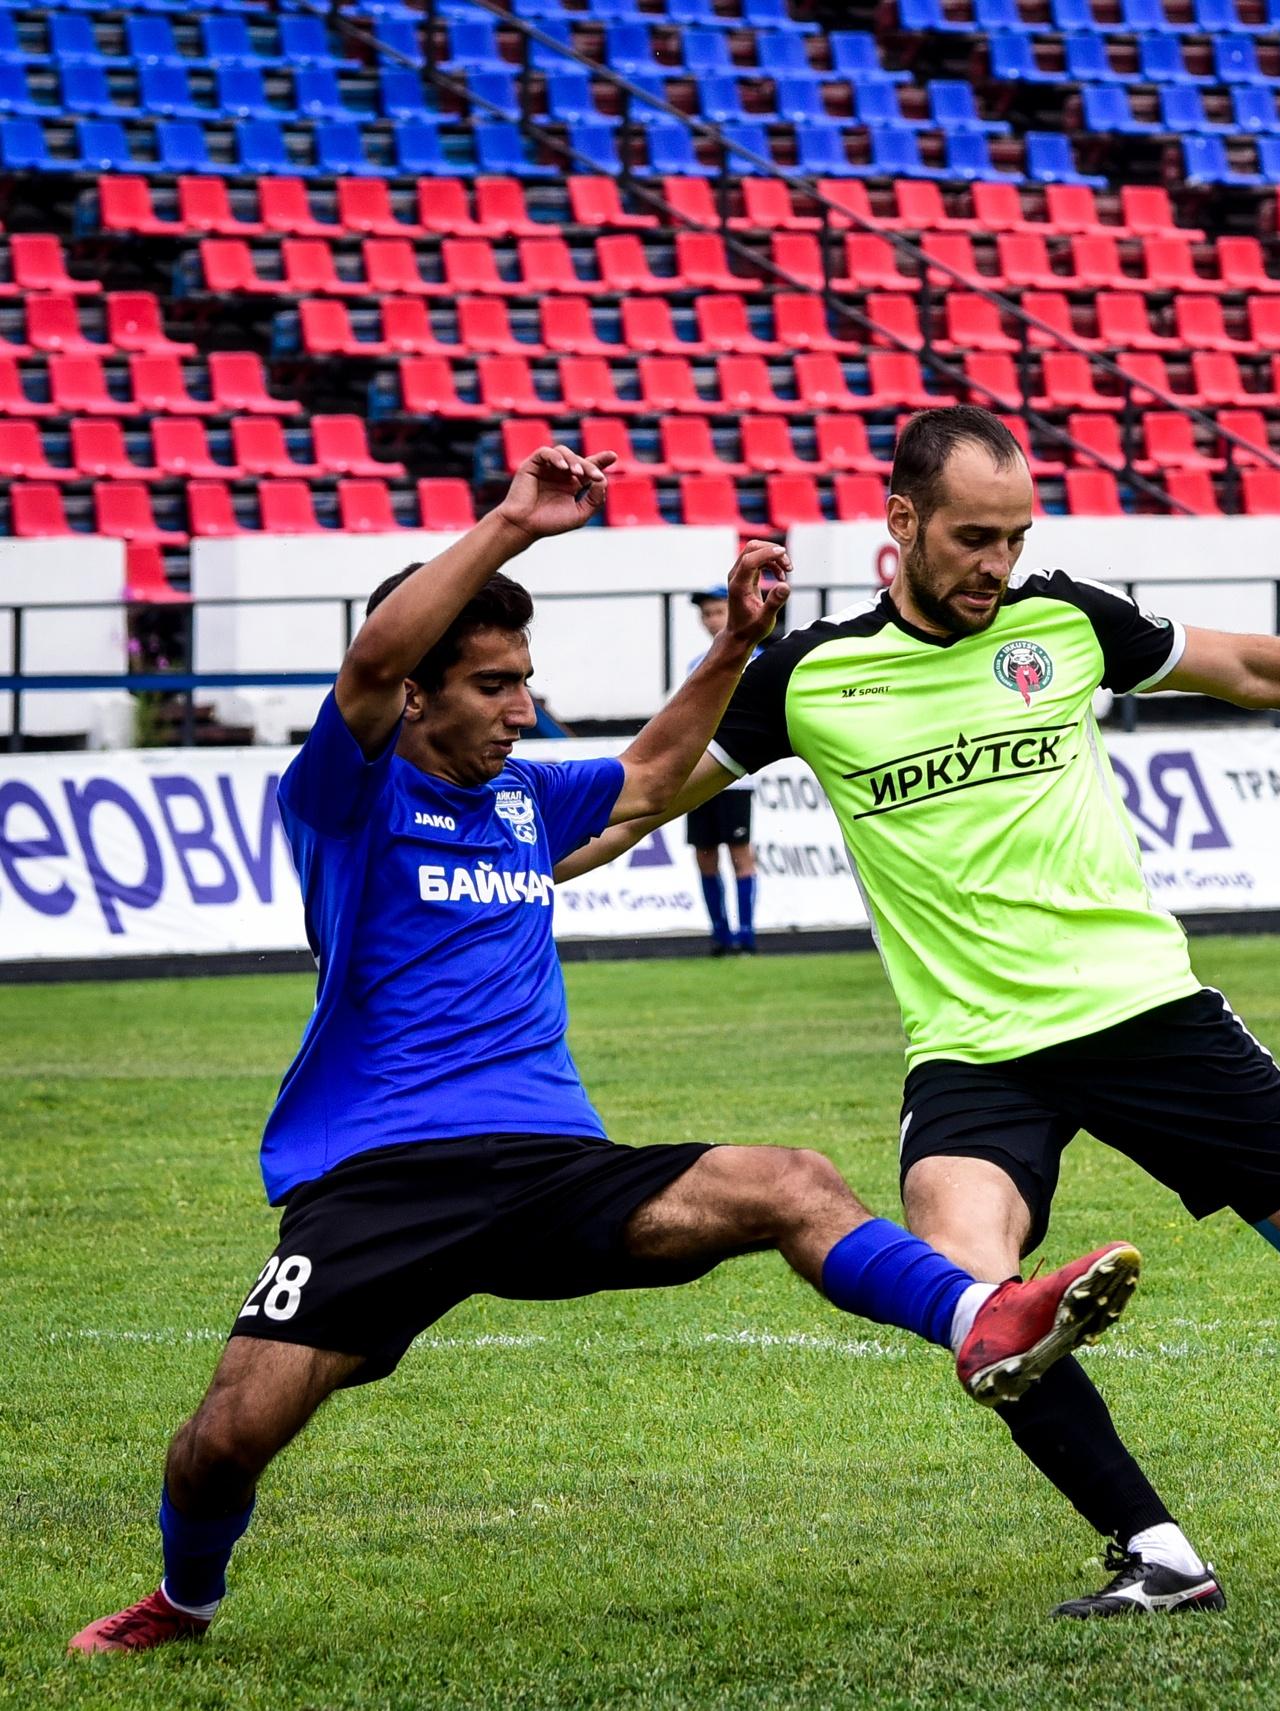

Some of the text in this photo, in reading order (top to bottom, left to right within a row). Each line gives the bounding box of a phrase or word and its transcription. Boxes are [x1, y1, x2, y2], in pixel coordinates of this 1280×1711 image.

[1002, 642, 1038, 654] IRKUTSK
[859, 685, 891, 696] SPORT
[869, 735, 1060, 806] ИРКУТСК
[494, 790, 522, 801] АЙКАЛ
[755, 776, 831, 810] СПО
[414, 811, 456, 832] JAKO
[238, 1254, 313, 1321] 28
